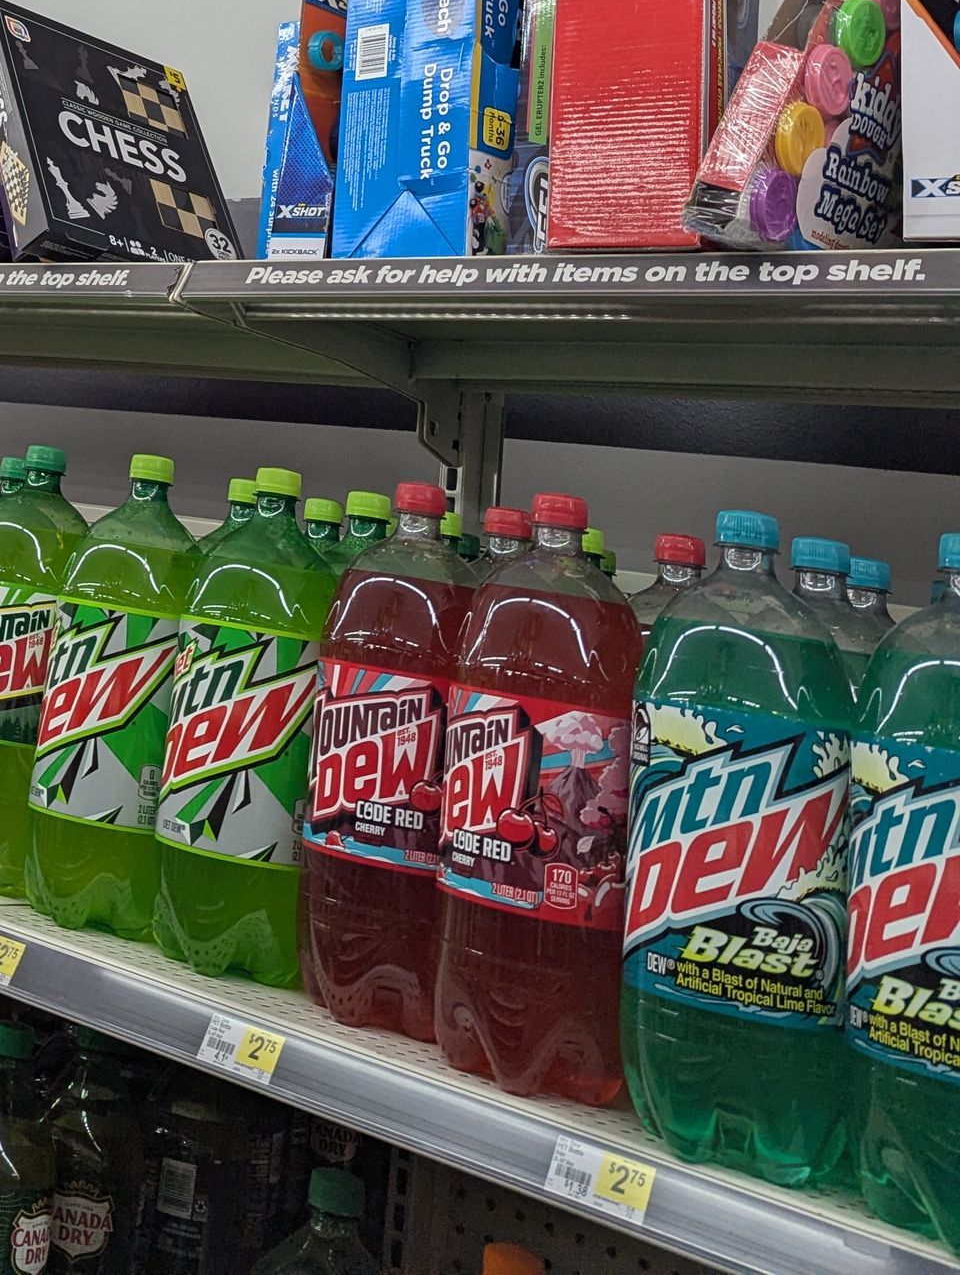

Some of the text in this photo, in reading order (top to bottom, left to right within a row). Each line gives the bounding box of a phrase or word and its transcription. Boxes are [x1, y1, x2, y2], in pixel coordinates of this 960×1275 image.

[535, 44, 547, 136] GEL includes:
[62, 101, 167, 143] CLASSIC WOODEN GAME COLLECTION
[420, 63, 437, 180] Dump Truck
[436, 68, 454, 169] Drop & Go
[851, 114, 886, 150] DOUGH
[58, 111, 186, 182] CHESS
[826, 153, 890, 204] Rainbow
[818, 191, 886, 243] Mega Set
[109, 234, 124, 247] 8+
[150, 247, 157, 255] 2
[209, 233, 231, 254] 32
[4, 270, 38, 286] the
[39, 272, 73, 288] top
[74, 269, 128, 286] shelf.
[245, 258, 925, 287] Please ask for help with items on the top shelf.
[28, 638, 44, 649] 1948
[397, 732, 416, 747] 1948
[485, 756, 503, 771] 1948
[356, 800, 424, 830] CODE RED
[637, 761, 772, 853] Mtn
[355, 822, 386, 837] CHERRY
[404, 849, 426, 862] 2 LITER
[452, 828, 512, 862] CODE RED
[452, 851, 476, 867] CHERRY
[550, 882, 572, 891] CALORIES
[553, 868, 572, 884] 170
[492, 882, 514, 899] 2 LITER
[681, 925, 820, 978] Blast
[752, 926, 811, 954] Baja
[676, 961, 700, 978] with
[701, 967, 709, 980] a
[712, 964, 743, 987] Blast
[745, 975, 758, 989] of
[761, 978, 803, 998] Natural
[804, 986, 823, 1000] and
[676, 972, 836, 1016] Artificial Tropical Lime Flavor
[868, 1028, 910, 1053] Artificial
[869, 1014, 946, 1046] with a Blast of
[57, 1227, 95, 1246] DRY
[25, 1248, 48, 1265] DRY
